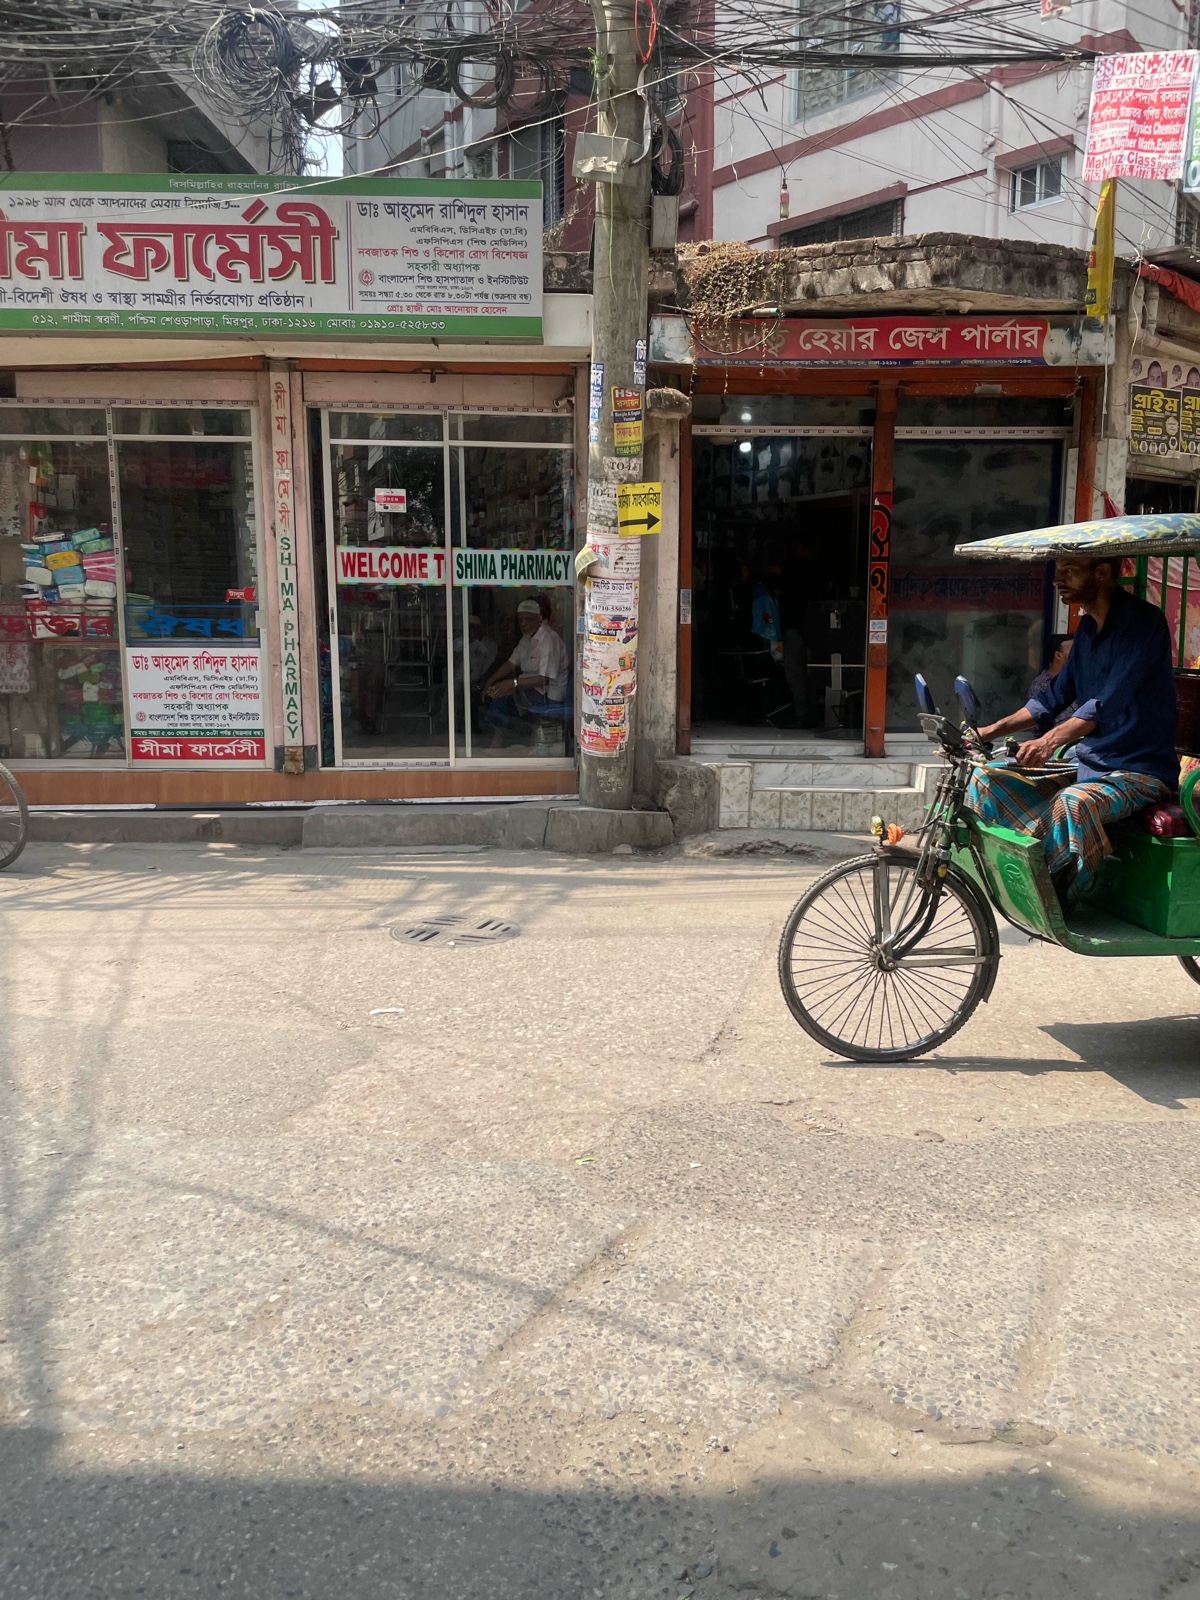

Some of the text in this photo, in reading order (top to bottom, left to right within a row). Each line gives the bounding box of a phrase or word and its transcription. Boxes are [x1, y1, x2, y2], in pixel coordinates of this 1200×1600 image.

[1086, 154, 1123, 169] Mahfuz
[1128, 151, 1156, 167] Class
[9, 197, 40, 207] ১৯৯৮
[44, 197, 66, 207] সাল
[70, 197, 95, 207] থেকে
[98, 197, 147, 208] আপনাদের
[151, 198, 181, 209] সেবায়
[356, 201, 379, 218] ডাঃ
[439, 199, 488, 224] রাশিদুল
[491, 205, 530, 222] হাসান
[410, 226, 456, 236] এমবিবিএস,
[459, 227, 497, 237] ডিসিএইচ
[97, 198, 338, 283] ফার্মেসী
[416, 237, 463, 248] এফসিপিএস
[467, 238, 487, 249] (শিশু
[357, 247, 530, 262] নবজাতক শিশু ও কিশোর রোগ বিশেষজ্ঞ
[407, 260, 481, 274] সহকারী অধ্যাপক
[378, 274, 530, 286] বাংলাদেশ শিশু হাসপাতাল ও ইনস্টিটিউট
[60, 287, 88, 304] ঔষধ
[93, 293, 103, 304] ও
[108, 292, 138, 308] স্বাস্থ্য
[142, 289, 187, 306] সামগ্রীর
[191, 289, 254, 307] নির্ভরযোগ্য
[415, 291, 432, 299] থেকে
[406, 303, 423, 313] হাজী
[445, 304, 478, 314] আনোয়ার
[481, 306, 508, 314] হোসেন
[32, 315, 58, 326] ৫১২,
[62, 312, 91, 325] শামীম
[128, 313, 156, 325] পশ্চিম
[222, 315, 258, 329] মিরপুর,
[799, 326, 879, 355] হেয়ার
[961, 318, 1044, 350] পার্লার
[1133, 389, 1180, 413] প্রাইম
[280, 537, 294, 611] SHIMA
[340, 551, 447, 580] WELCOME T
[456, 553, 571, 581] SHIMA PHARMACY
[138, 608, 246, 637] ঔষধ
[132, 656, 149, 671] ডাঃ
[192, 651, 227, 676] রাশিদুল
[230, 656, 259, 672] হাসান
[133, 692, 163, 701] নবজাতক
[165, 691, 178, 701] শিশু
[189, 691, 213, 702] কিশোর
[215, 693, 230, 702] রোগ
[233, 692, 260, 702] বিশেষজ্ঞ
[163, 702, 230, 712] সহকারী অধ্যাপক
[148, 713, 176, 722] বাংলাদেশ
[177, 712, 189, 722] শিশু
[191, 714, 220, 722] হাসপাতাল
[137, 739, 262, 758] সীমা ফার্মেসী
